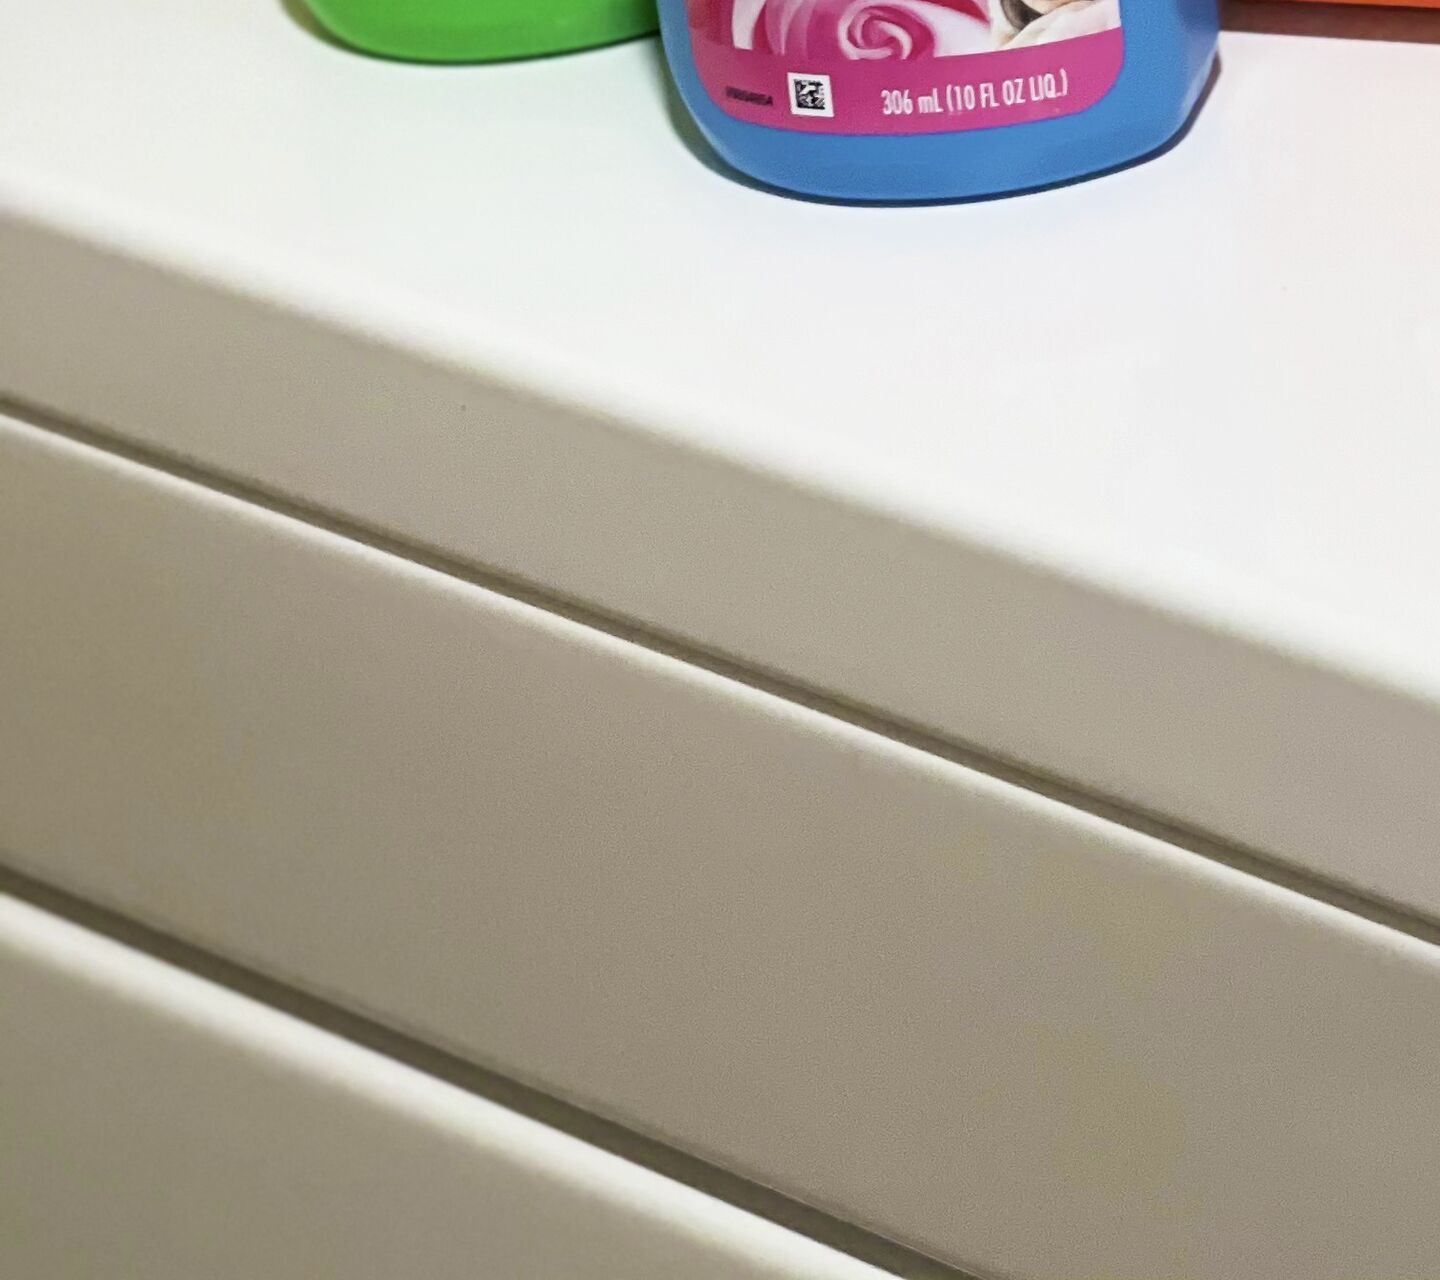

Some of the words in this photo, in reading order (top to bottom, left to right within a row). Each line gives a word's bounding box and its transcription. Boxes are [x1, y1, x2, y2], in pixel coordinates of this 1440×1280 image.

[881, 89, 913, 116] 306
[918, 87, 943, 114] mL
[946, 83, 976, 113] (10
[979, 81, 1000, 108] FL
[1002, 78, 1026, 106] OZ
[1028, 68, 1070, 102] LIQ.)
